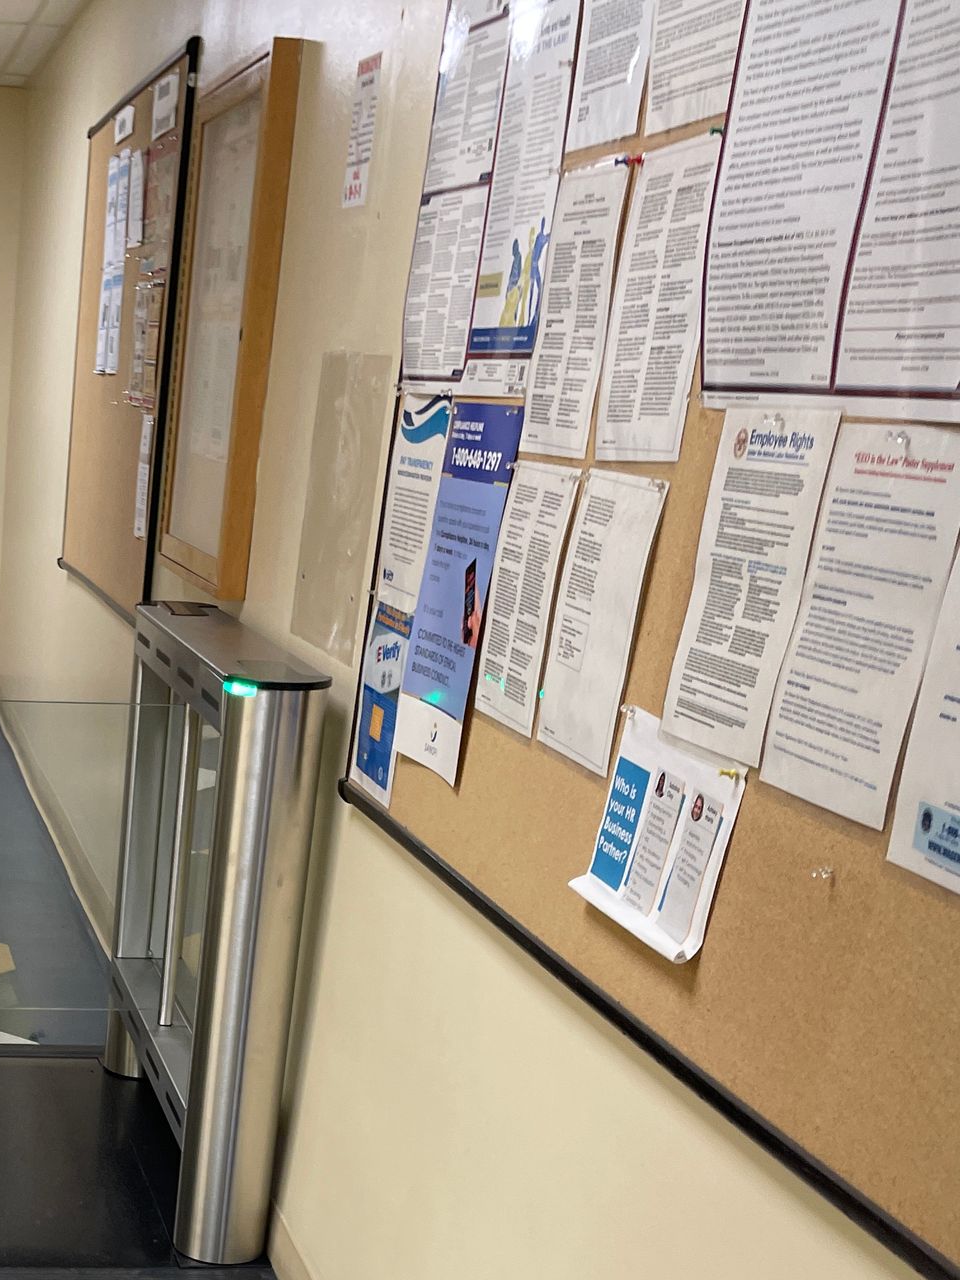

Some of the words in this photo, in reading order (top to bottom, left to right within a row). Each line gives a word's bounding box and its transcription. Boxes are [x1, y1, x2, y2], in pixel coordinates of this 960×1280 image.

[750, 429, 788, 449] Employee
[789, 431, 814, 452] Rights
[452, 447, 502, 472] 1-800-648-1297
[876, 454, 886, 465] the
[902, 457, 919, 469] Poster
[920, 458, 955, 472] Supplement
[614, 774, 630, 796] Who
[629, 784, 637, 799] is
[609, 798, 625, 816] your
[625, 805, 636, 823] HR
[603, 816, 632, 845] Business
[599, 836, 627, 864] Partner?
